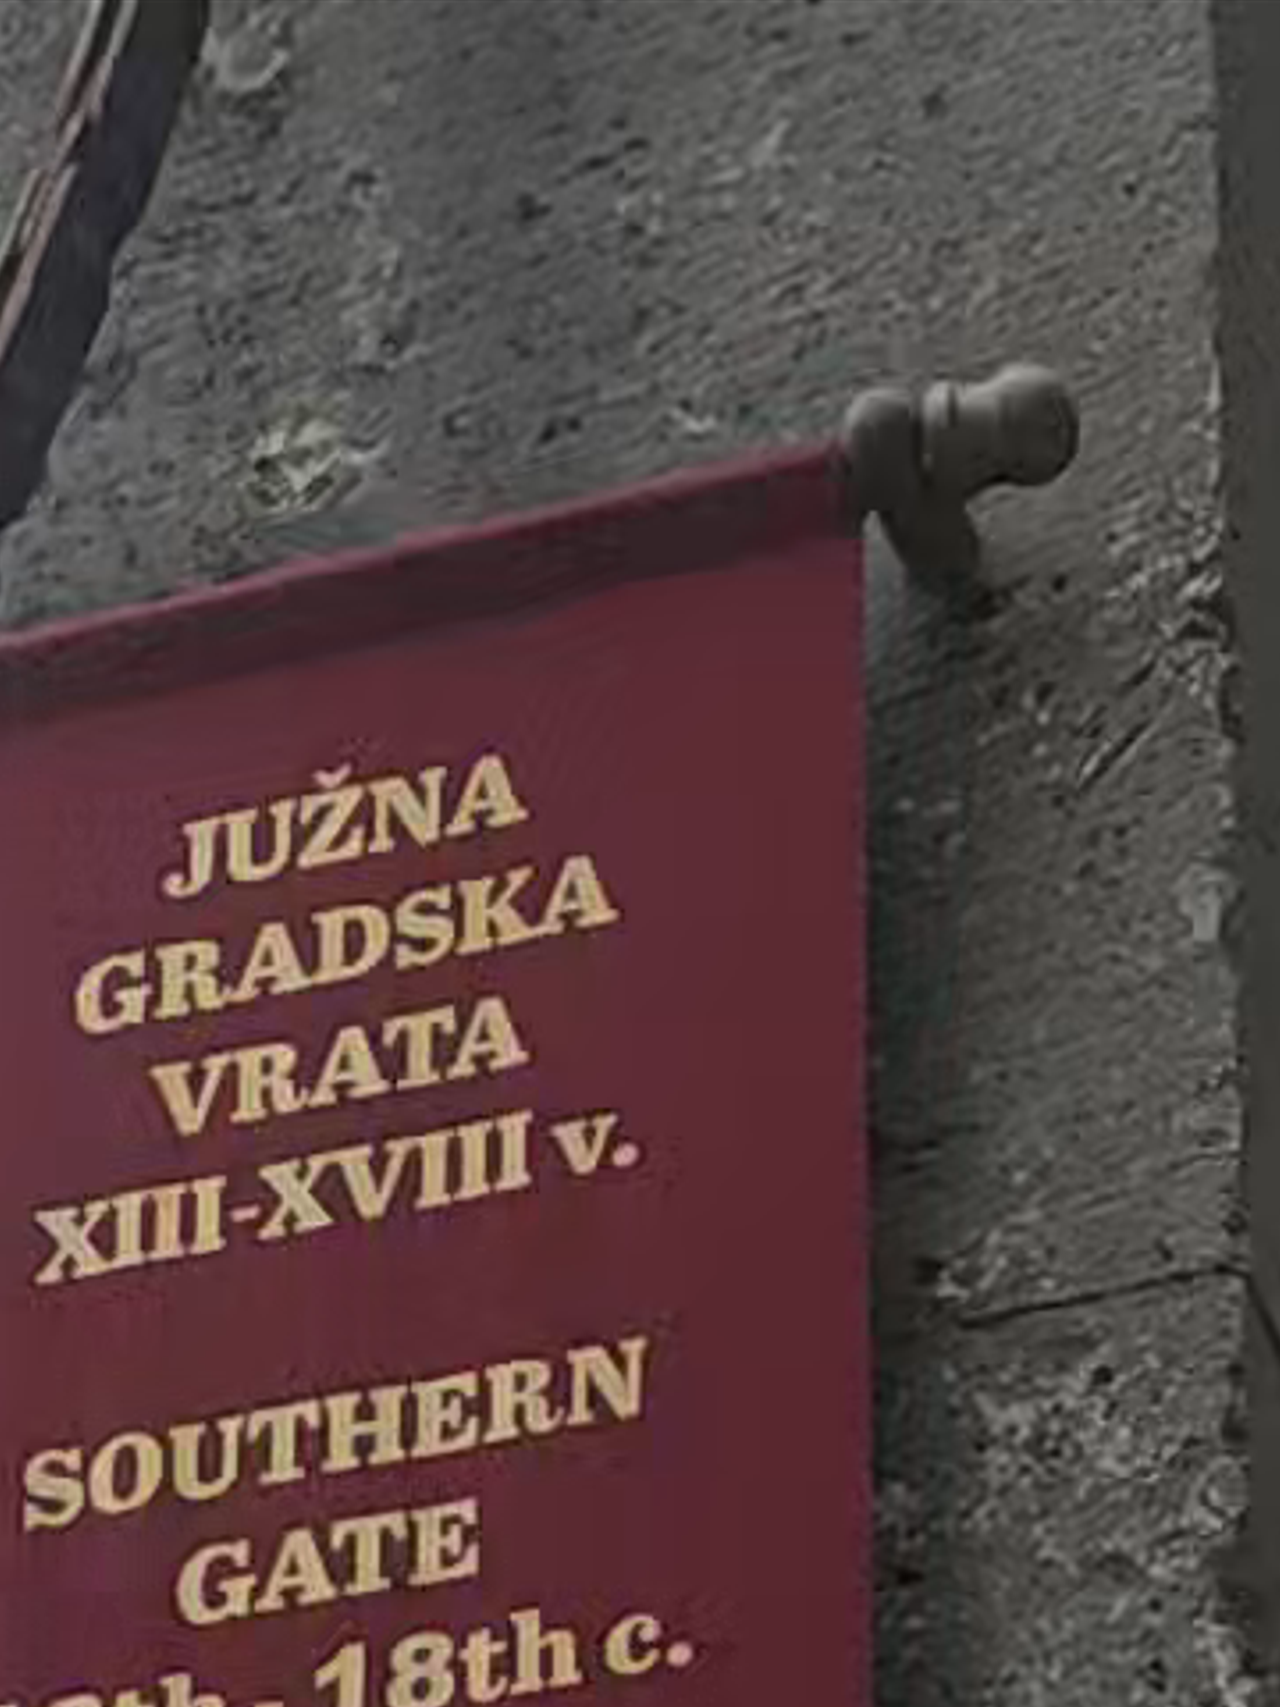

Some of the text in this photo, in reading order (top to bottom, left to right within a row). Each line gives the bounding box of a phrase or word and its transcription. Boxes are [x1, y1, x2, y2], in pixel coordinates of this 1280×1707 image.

[161, 753, 530, 900] JUŽNA
[73, 853, 620, 1036] GRADSKA
[147, 995, 531, 1138] VRATA
[33, 1108, 640, 1286] XIII-XVIII v.
[21, 1334, 649, 1532] SOUTHERN
[174, 1496, 481, 1627] GATE
[603, 1612, 694, 1676] c.
